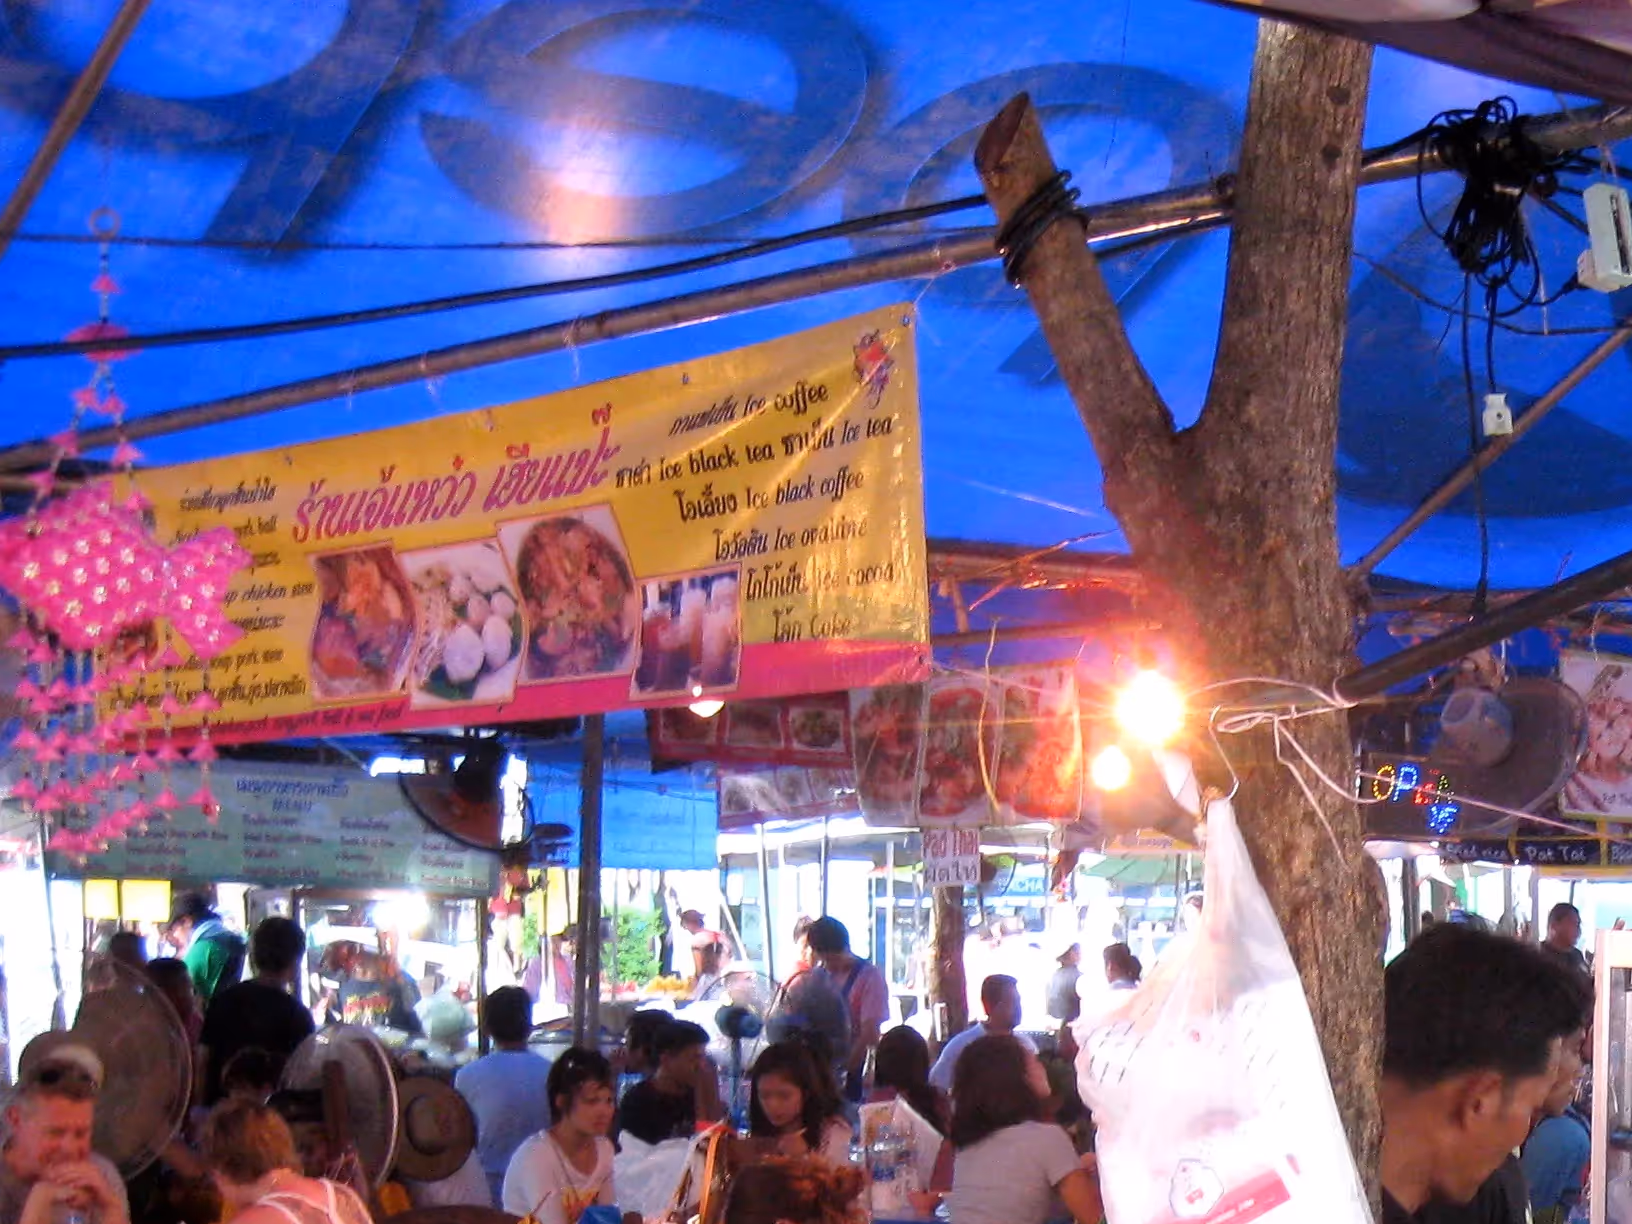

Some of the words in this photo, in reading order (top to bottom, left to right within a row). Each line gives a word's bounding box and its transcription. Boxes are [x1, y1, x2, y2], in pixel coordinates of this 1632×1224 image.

[743, 393, 766, 416] Ice
[775, 381, 829, 416] coffee
[659, 459, 683, 482] Ice
[689, 443, 739, 476] black
[840, 420, 860, 446] Ice
[867, 415, 894, 440] tea
[747, 487, 768, 511] Ice
[775, 475, 815, 506] black
[820, 466, 865, 504] coffee
[774, 526, 796, 551] Ice
